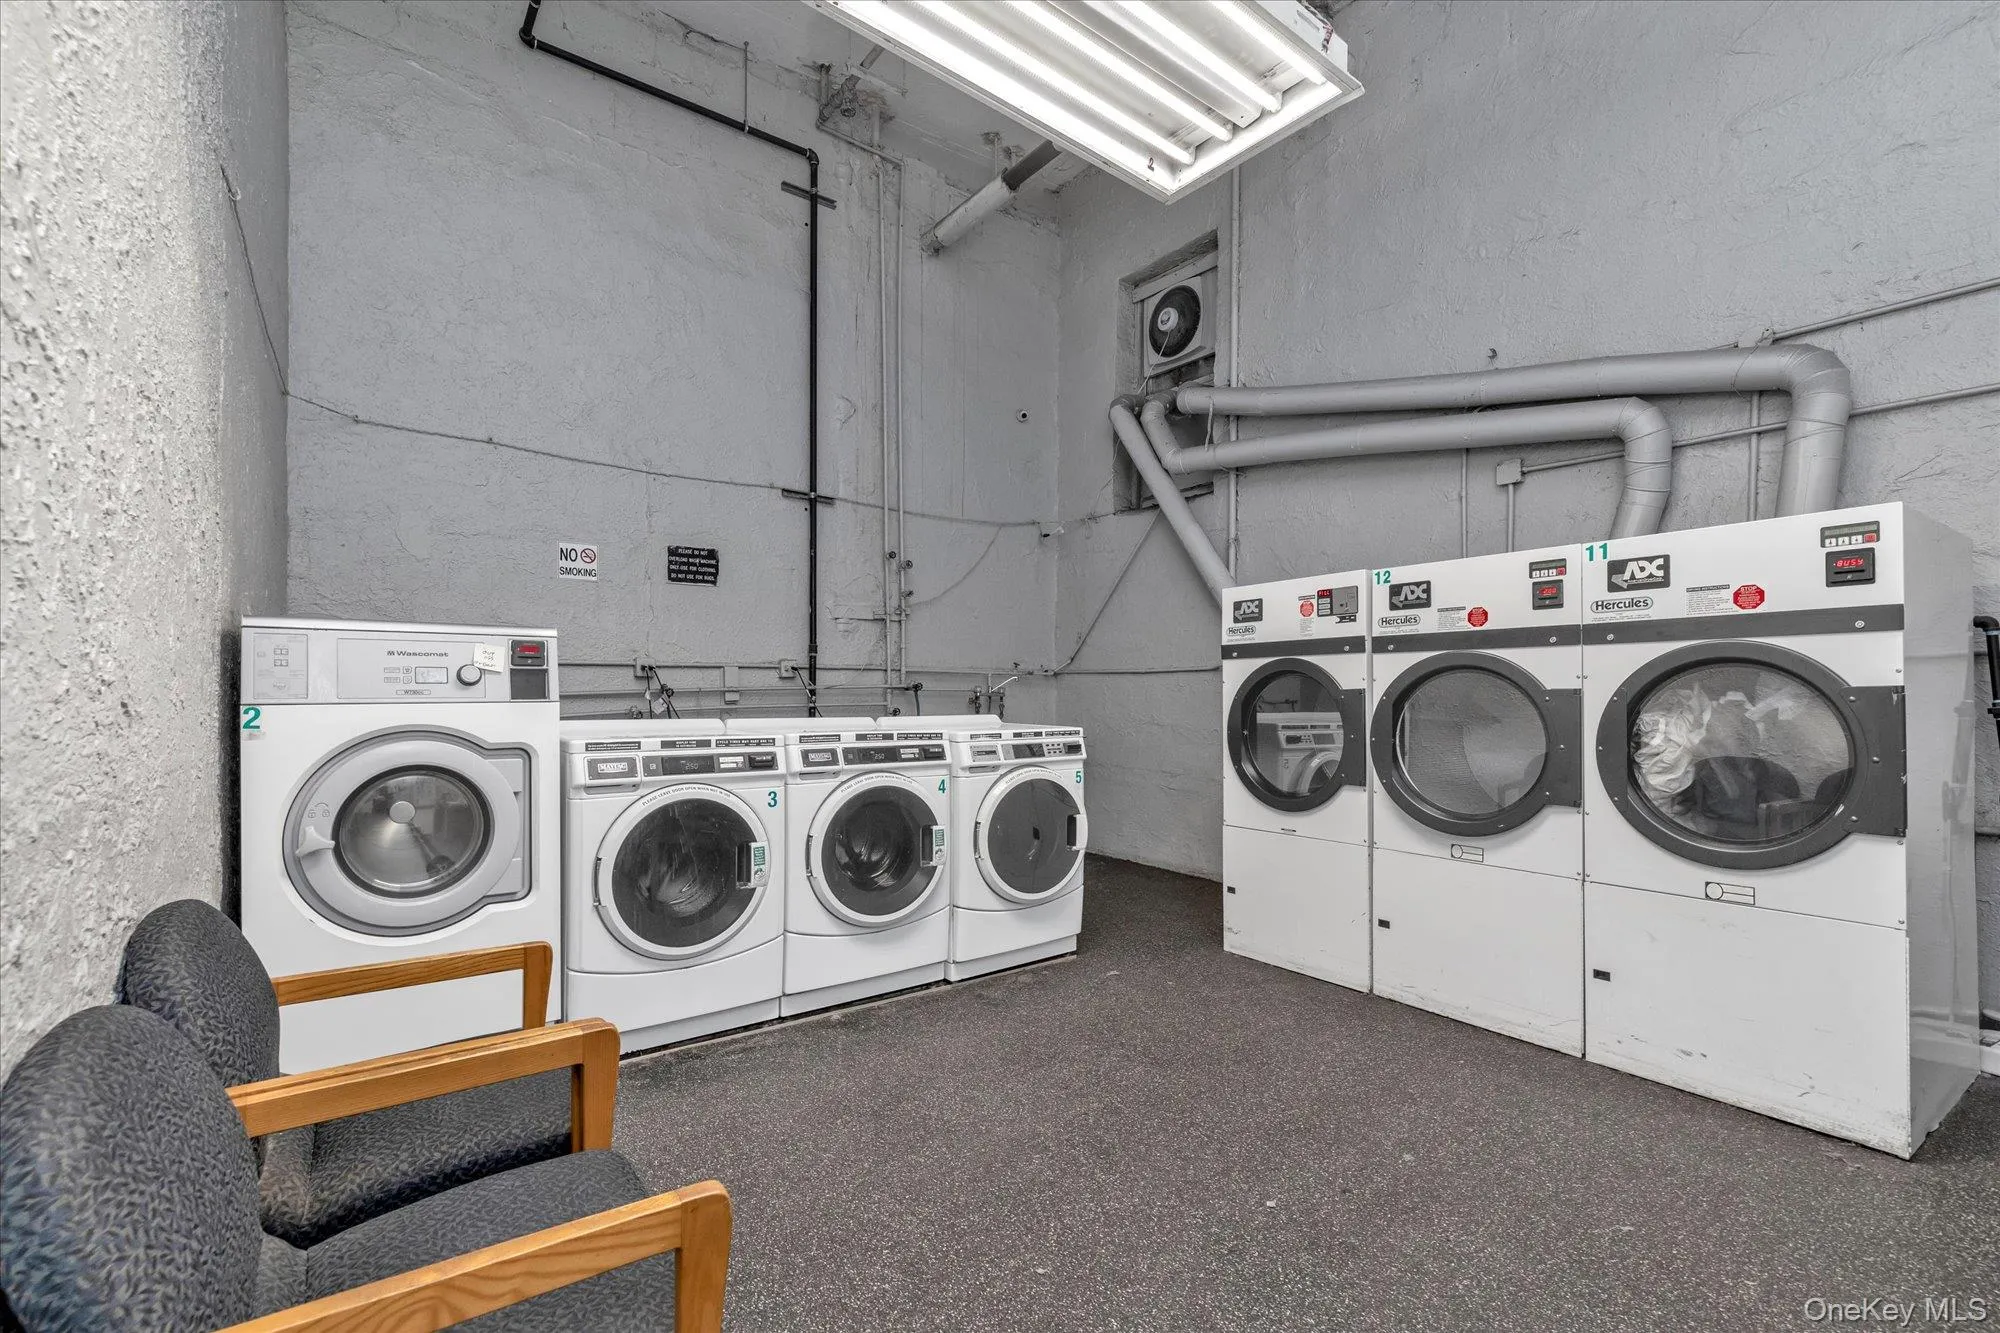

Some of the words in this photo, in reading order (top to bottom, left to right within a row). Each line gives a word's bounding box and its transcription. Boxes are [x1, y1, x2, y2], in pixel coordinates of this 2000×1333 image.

[560, 547, 578, 562] NO
[1585, 542, 1608, 562] 11
[559, 566, 597, 577] SMOKING
[1623, 558, 1665, 580] ADC
[1374, 570, 1391, 585] 12
[1400, 583, 1427, 601] ADC
[1240, 600, 1259, 614] ADC
[1595, 598, 1649, 610] Hercules
[1381, 615, 1418, 626] Hercules
[1228, 626, 1255, 635] Hercules
[242, 706, 261, 730] 2
[1075, 770, 1082, 783] 5
[937, 779, 947, 794] 4
[767, 791, 778, 807] 3
